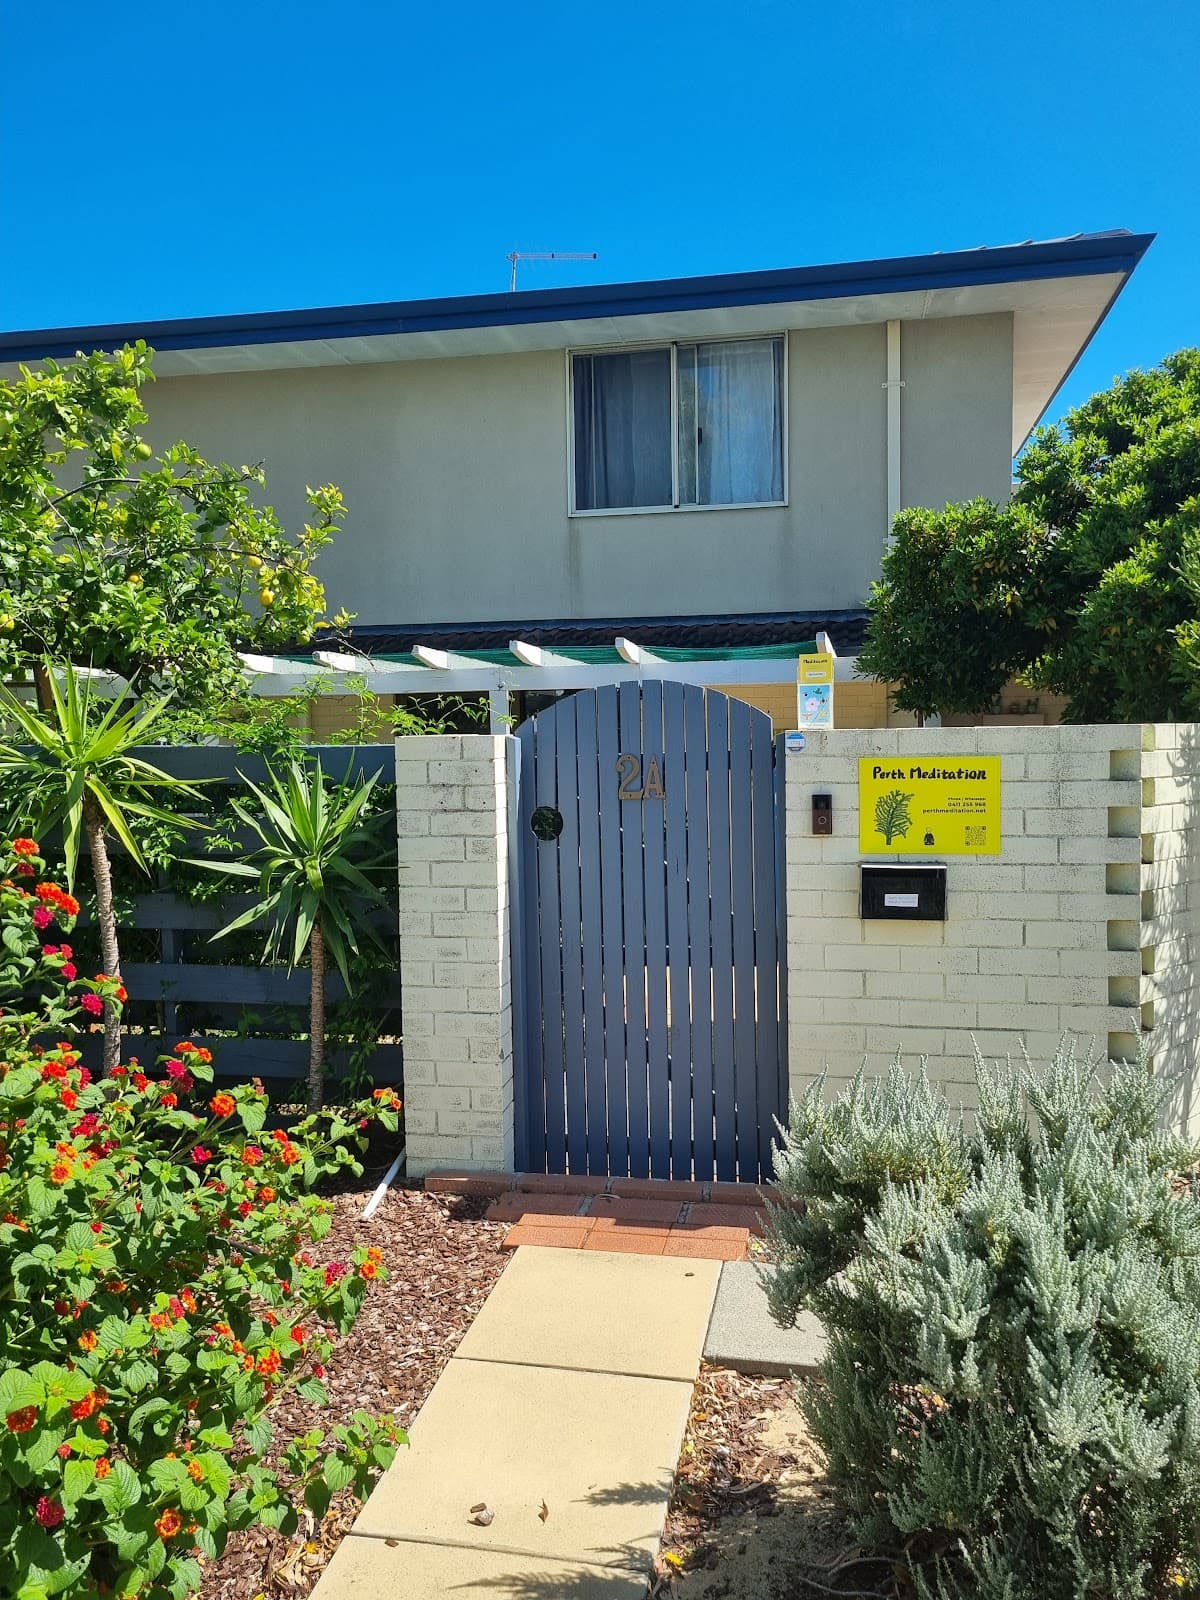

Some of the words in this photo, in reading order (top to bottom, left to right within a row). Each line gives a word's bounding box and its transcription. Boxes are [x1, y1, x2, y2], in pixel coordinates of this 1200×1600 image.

[616, 754, 665, 800] 2A
[872, 766, 906, 779] Perth
[910, 766, 987, 780] Meditation
